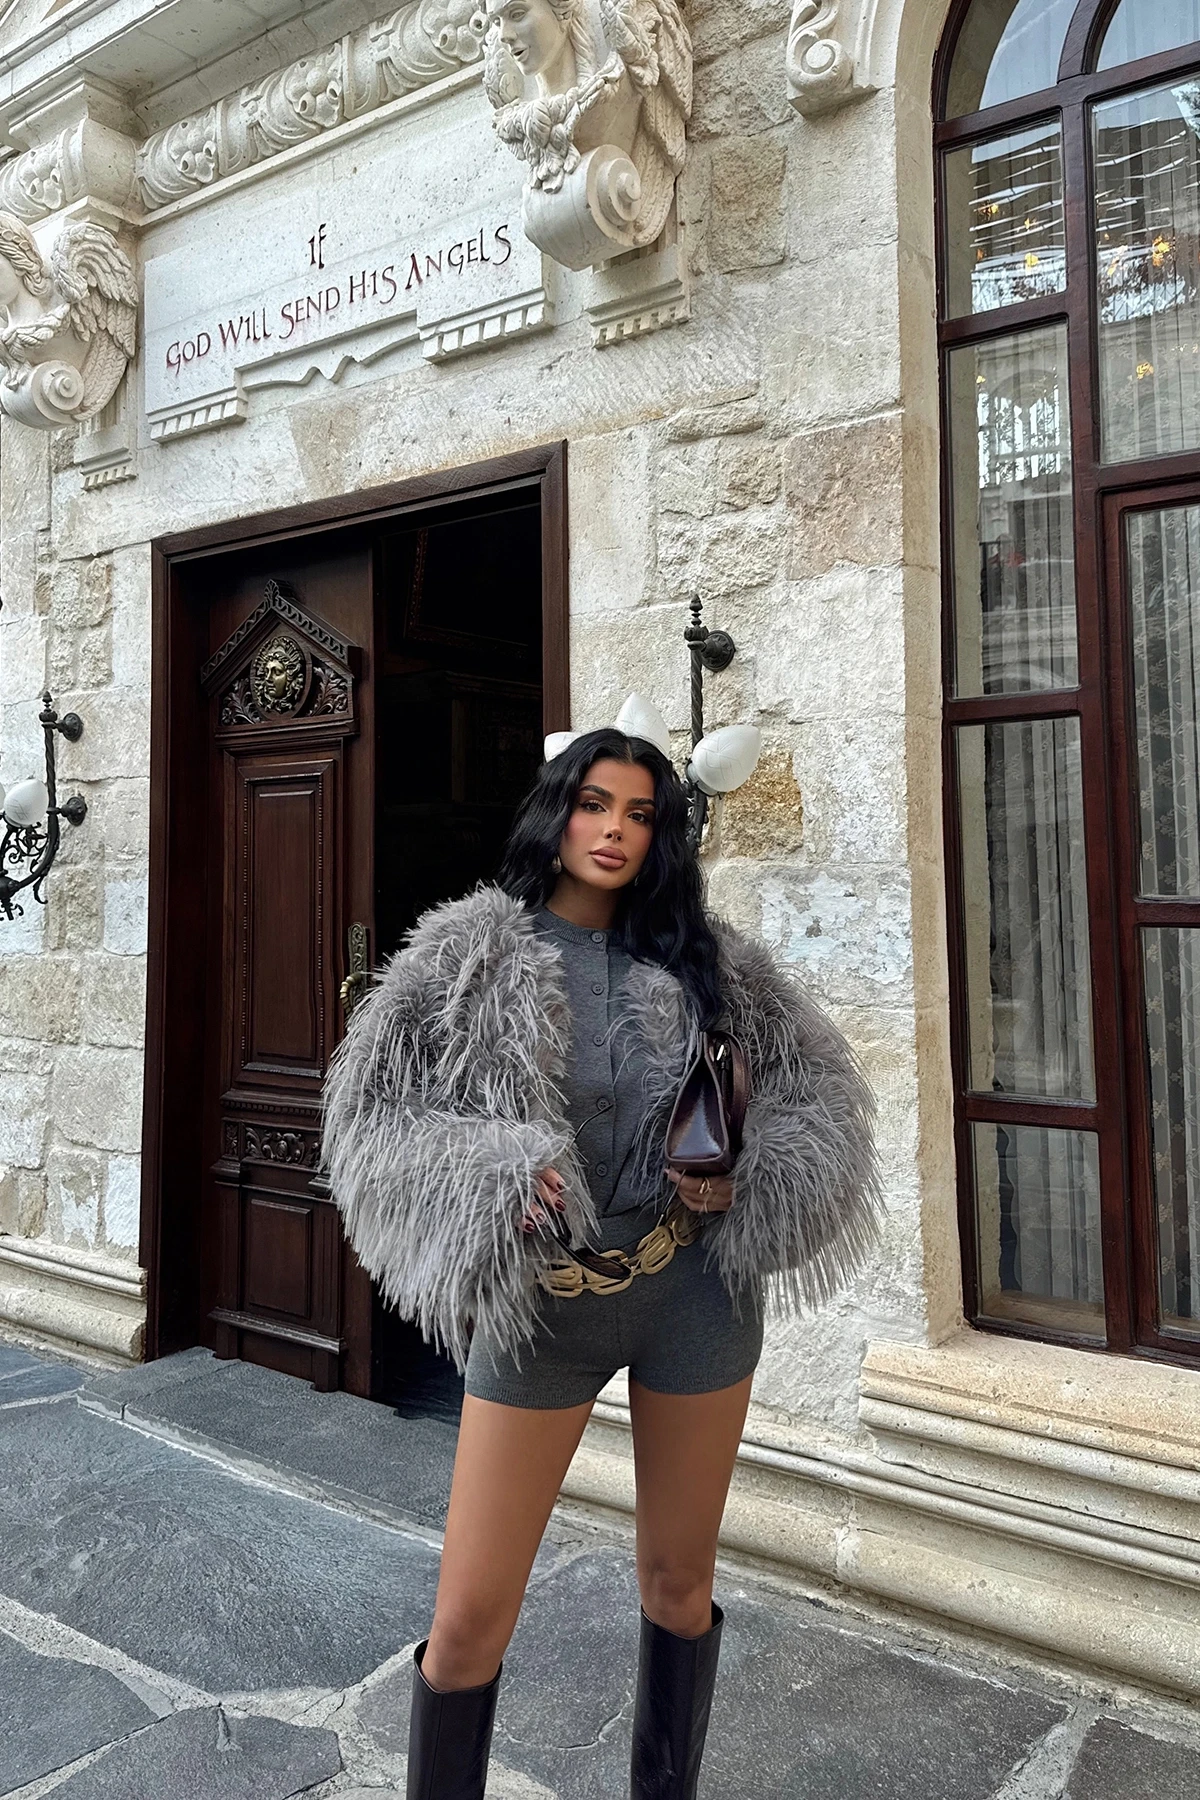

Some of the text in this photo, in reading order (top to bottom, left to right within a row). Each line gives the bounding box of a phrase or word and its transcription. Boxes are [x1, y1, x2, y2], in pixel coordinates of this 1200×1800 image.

[278, 286, 341, 339] SEND
[349, 265, 397, 304] HIS
[405, 224, 512, 290] ANGELS
